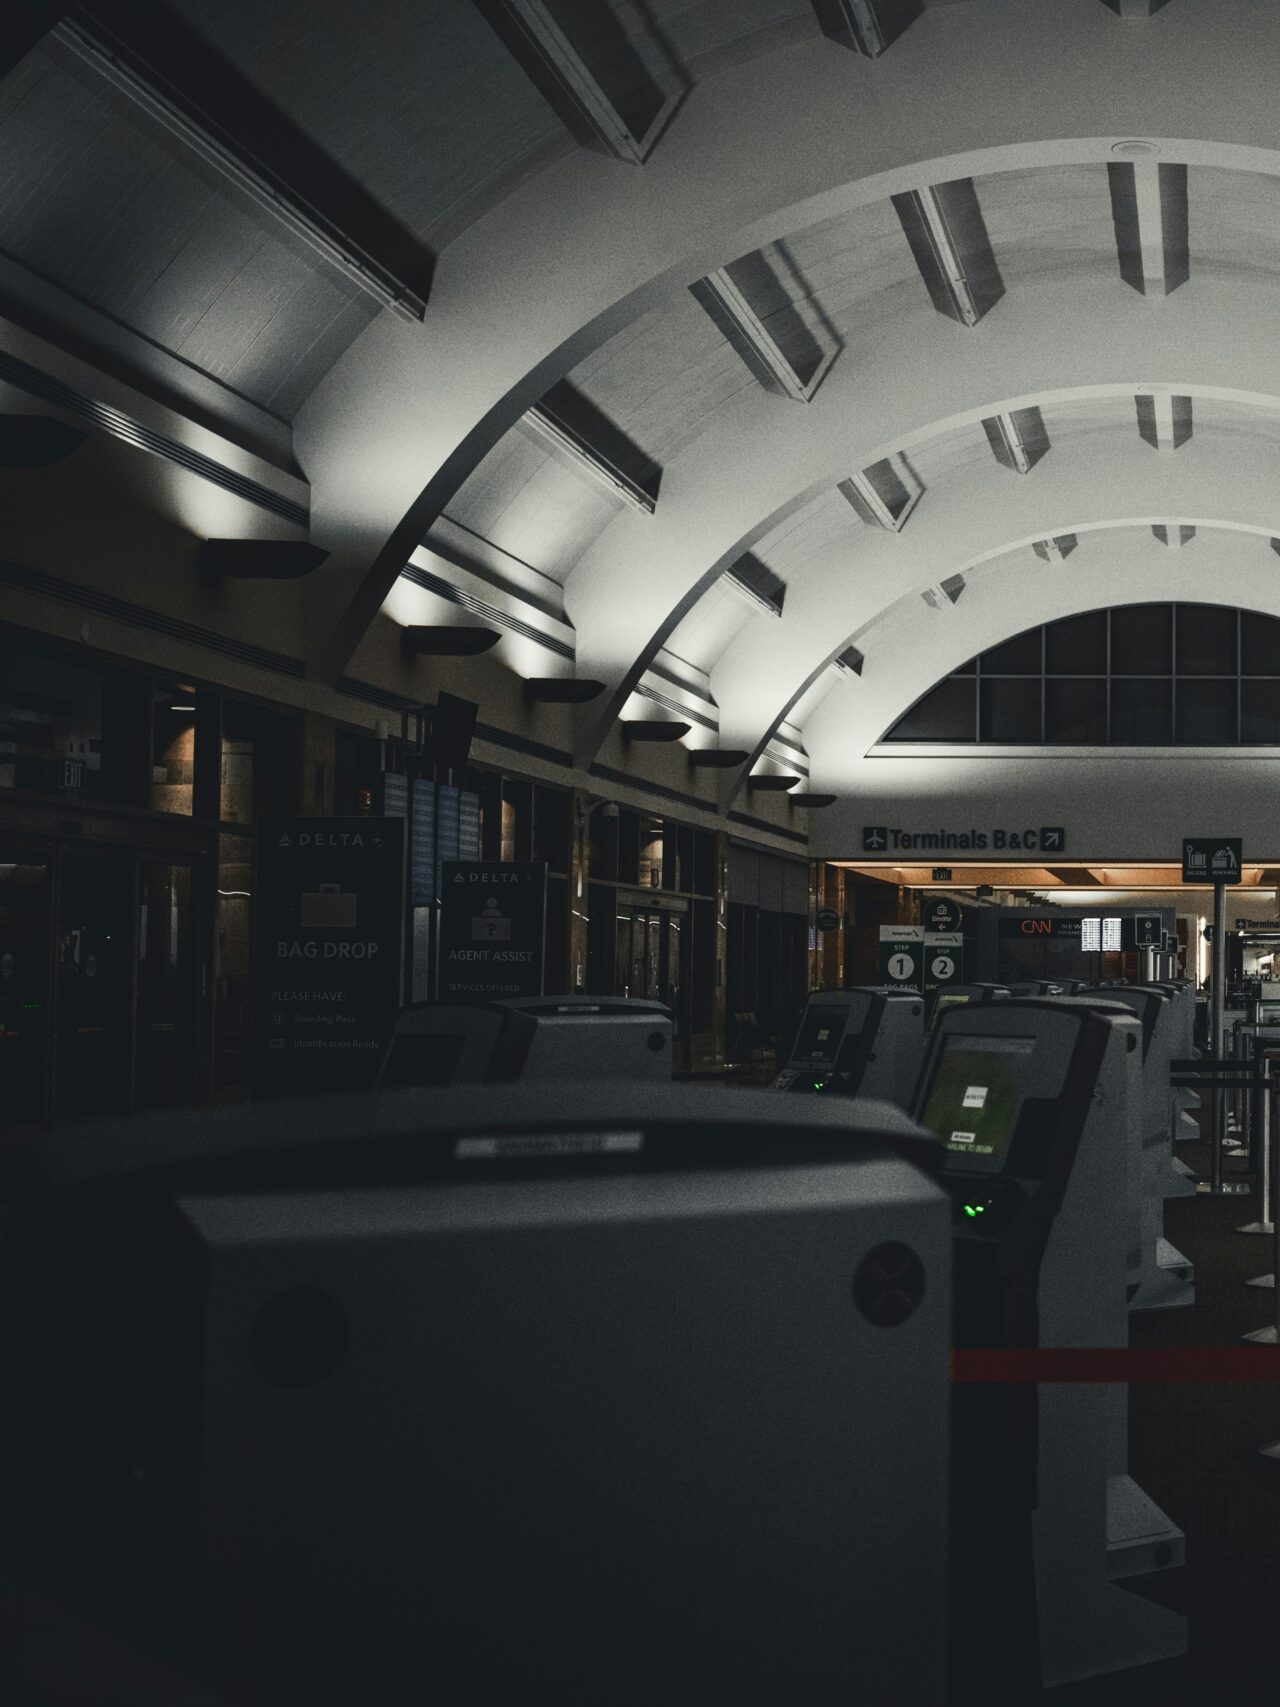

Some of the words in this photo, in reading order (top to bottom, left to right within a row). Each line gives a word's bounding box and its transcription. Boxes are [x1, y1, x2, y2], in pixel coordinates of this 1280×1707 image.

[65, 761, 82, 788] EXIT
[299, 834, 364, 846] DELTA
[890, 829, 988, 850] Terminals
[470, 872, 519, 882] DELTA
[1021, 920, 1052, 934] CNN
[278, 942, 318, 958] BAG
[324, 942, 378, 959] DROP
[448, 950, 490, 961] AGENT
[492, 951, 533, 962] ASSIST
[896, 958, 904, 975] 1
[939, 960, 948, 974] 2
[448, 984, 484, 992] SERVICES
[272, 991, 310, 1002] PLEASE
[313, 992, 346, 1002] HAVE:
[295, 1014, 334, 1026] Boarding
[336, 1014, 356, 1024] Pass
[294, 1039, 351, 1049] Identification
[352, 1040, 380, 1050] Ready
